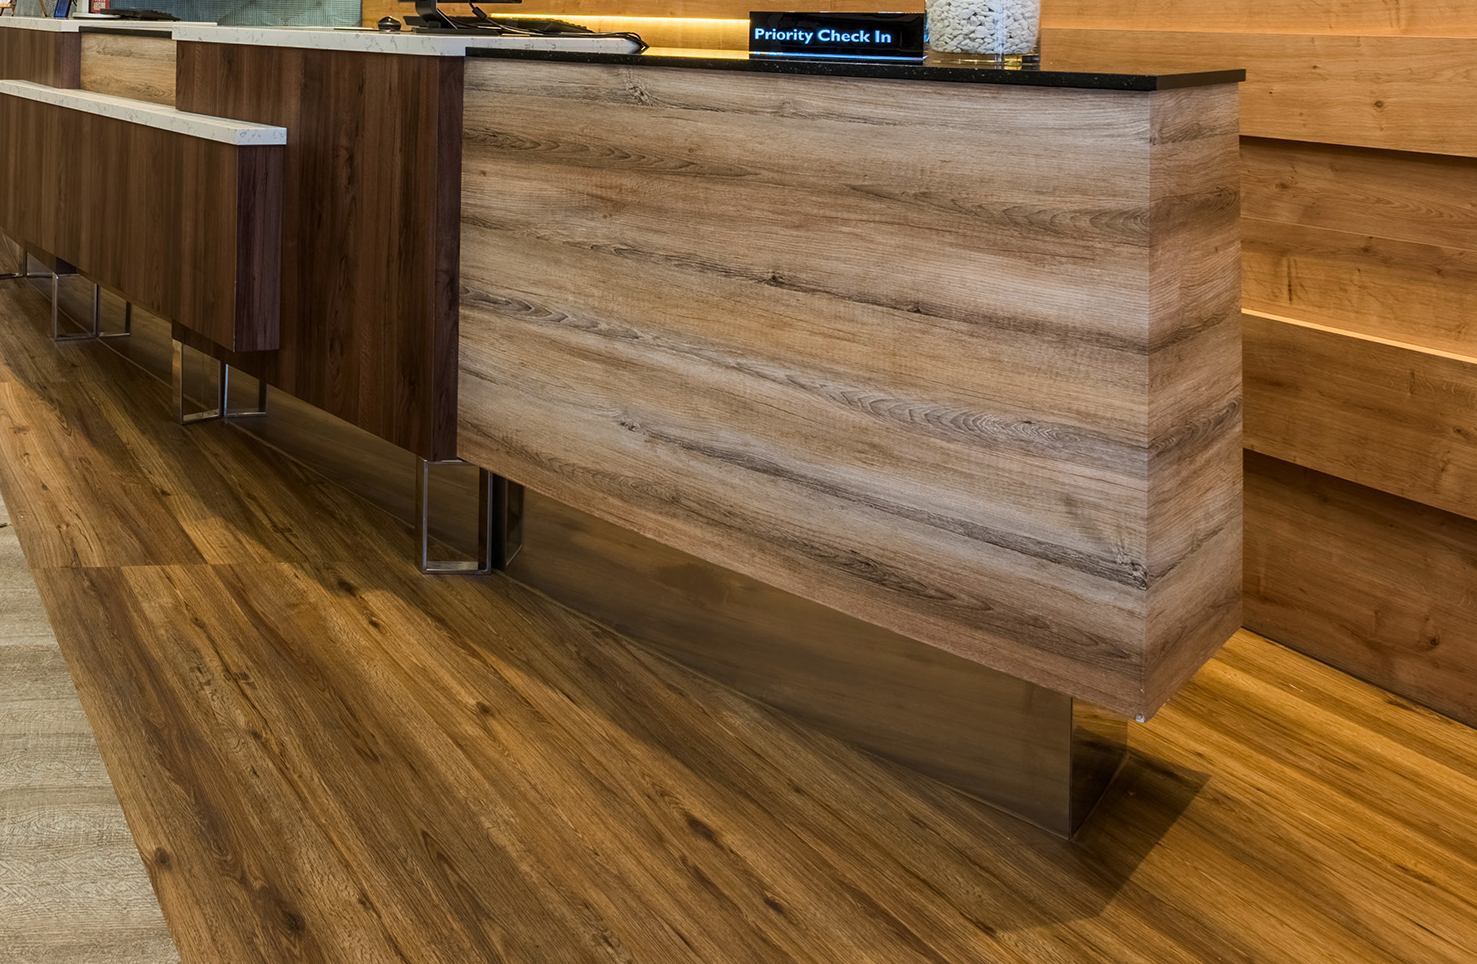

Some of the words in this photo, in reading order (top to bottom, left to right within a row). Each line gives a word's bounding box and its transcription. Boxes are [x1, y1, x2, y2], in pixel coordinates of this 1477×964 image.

[754, 27, 814, 44] Priority
[817, 28, 871, 43] Check
[874, 29, 892, 44] In
